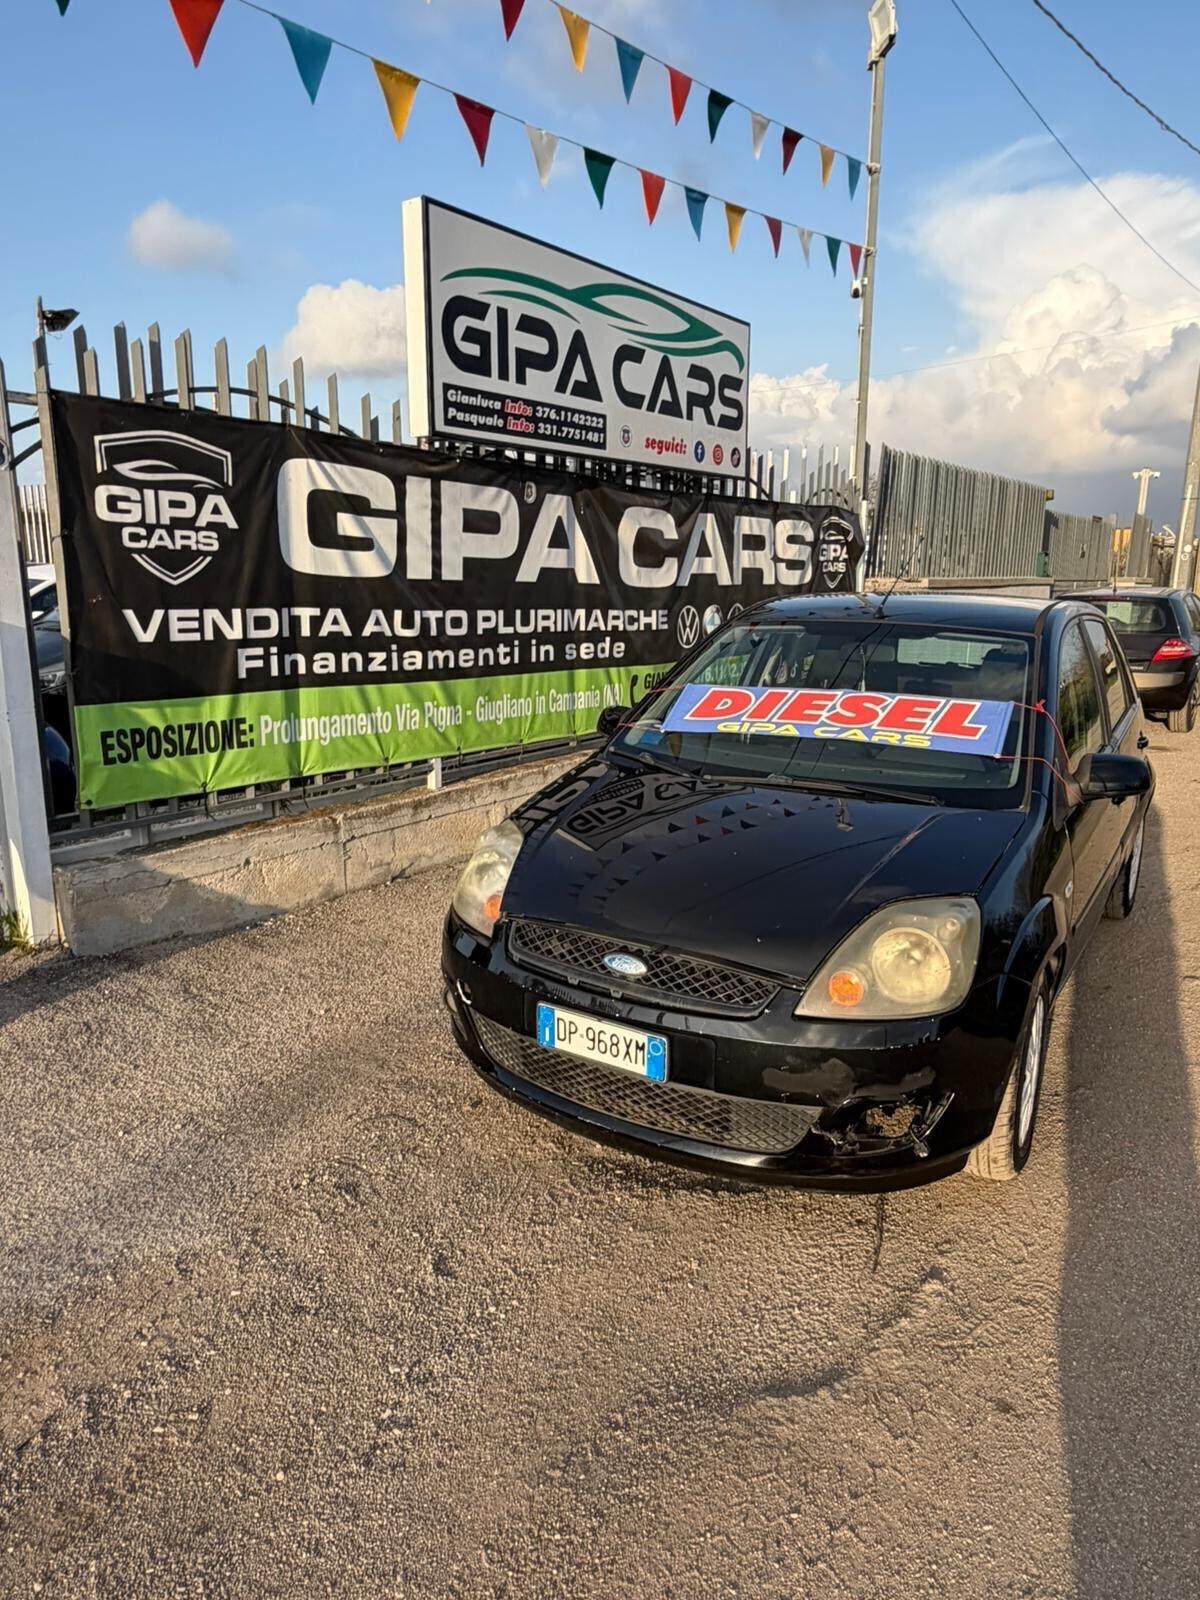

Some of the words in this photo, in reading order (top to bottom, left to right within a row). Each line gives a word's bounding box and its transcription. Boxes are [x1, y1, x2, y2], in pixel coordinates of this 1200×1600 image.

[441, 295, 604, 403] GIPA
[612, 344, 744, 432] CARS
[447, 389, 502, 410] Gianluca
[535, 406, 604, 429] 376.1142322
[448, 407, 504, 427] Pasquale
[537, 423, 604, 444] 331.7751481
[644, 437, 687, 455] seguici:
[94, 484, 239, 529] GIPA
[277, 458, 600, 584] GIPA
[618, 506, 814, 588] CARS
[121, 526, 219, 552] CARS
[822, 561, 846, 573] CARS
[122, 607, 352, 643] VENDITA
[361, 609, 468, 637] AUTO
[476, 608, 669, 635] PLURIMARCHE
[237, 639, 520, 679] Finanziamenti
[530, 639, 555, 663] in
[565, 636, 626, 661] sede
[100, 717, 254, 766] ESPOSIZIONE:
[259, 702, 392, 747] Prolungamento
[395, 703, 420, 731] Via
[425, 700, 463, 733] Pigna
[476, 694, 532, 725] Giugliano
[535, 692, 546, 713] in
[549, 685, 600, 713] Campania
[602, 683, 625, 706] (NA)
[683, 687, 988, 740] DIESEL
[716, 722, 800, 736] GIPA
[812, 727, 932, 748] CARS
